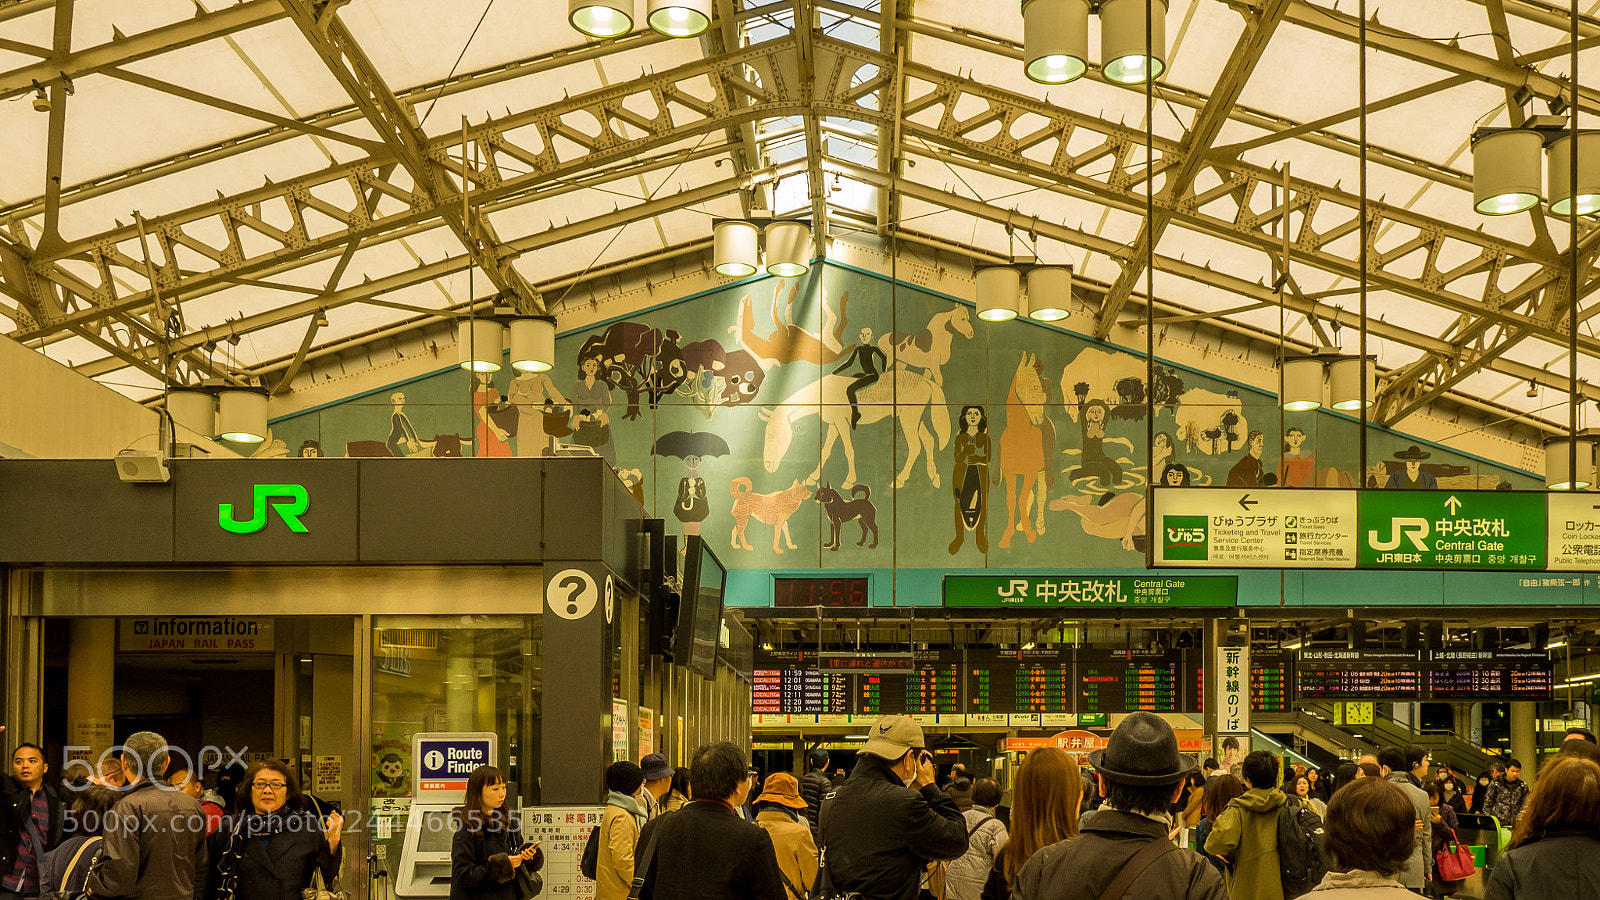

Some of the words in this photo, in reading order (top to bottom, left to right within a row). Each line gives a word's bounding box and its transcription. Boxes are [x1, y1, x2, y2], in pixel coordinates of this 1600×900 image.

[219, 484, 309, 533] JR
[1213, 515, 1278, 527] びゅうプラザ
[1299, 516, 1339, 524] きっぷうりば
[1566, 521, 1600, 531] ロッカー
[1213, 528, 1244, 537] Ticketing
[1368, 517, 1430, 551] JR
[1435, 517, 1510, 538] 中央改札
[1167, 528, 1205, 542] びゅう
[1299, 532, 1348, 540] 旅行カウンター
[1299, 548, 1343, 556] 指定席券売機
[1435, 540, 1475, 551] Central
[1477, 540, 1504, 551] Gate
[1376, 553, 1422, 564] JR東日本
[998, 580, 1029, 596] JR
[1134, 579, 1163, 588] Central
[1165, 579, 1186, 588] Gate
[789, 580, 864, 605] 11:56
[1036, 580, 1127, 603] 中央改札
[153, 618, 258, 635] information
[148, 639, 185, 649] JAPAN
[194, 639, 219, 648] RAIL
[227, 639, 255, 648] PASS
[1226, 652, 1240, 730] 新幹線のりば
[447, 747, 483, 760] Route
[447, 760, 485, 774] Finde
